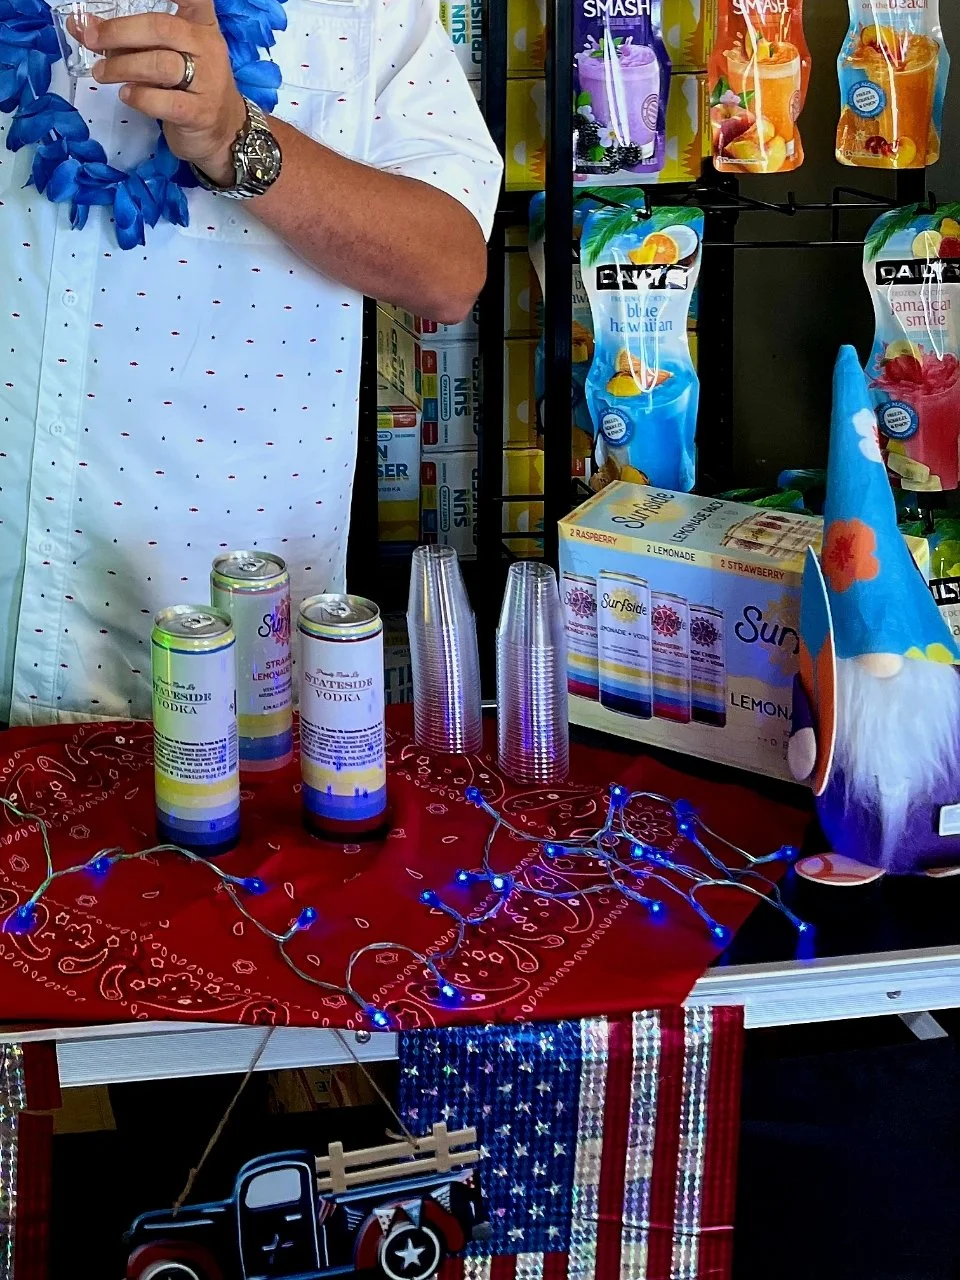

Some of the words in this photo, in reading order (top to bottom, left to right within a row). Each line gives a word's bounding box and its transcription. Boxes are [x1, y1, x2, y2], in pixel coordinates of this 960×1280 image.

[451, 3, 466, 45] SUN
[453, 377, 468, 417] SUN
[453, 488, 468, 528] SUN
[611, 491, 675, 530] Surfside
[570, 528, 575, 537] 2
[576, 529, 618, 546] RASPBERRY
[646, 544, 651, 553] 2
[653, 546, 696, 562] LEMONADE
[720, 560, 726, 568] 2
[727, 560, 785, 581] STRAWBERRY
[600, 592, 648, 616] Surfside
[304, 671, 373, 690] STATESIDE
[315, 689, 361, 702] VODKA
[157, 698, 198, 715] VODKA
[730, 693, 793, 720] LEMON
